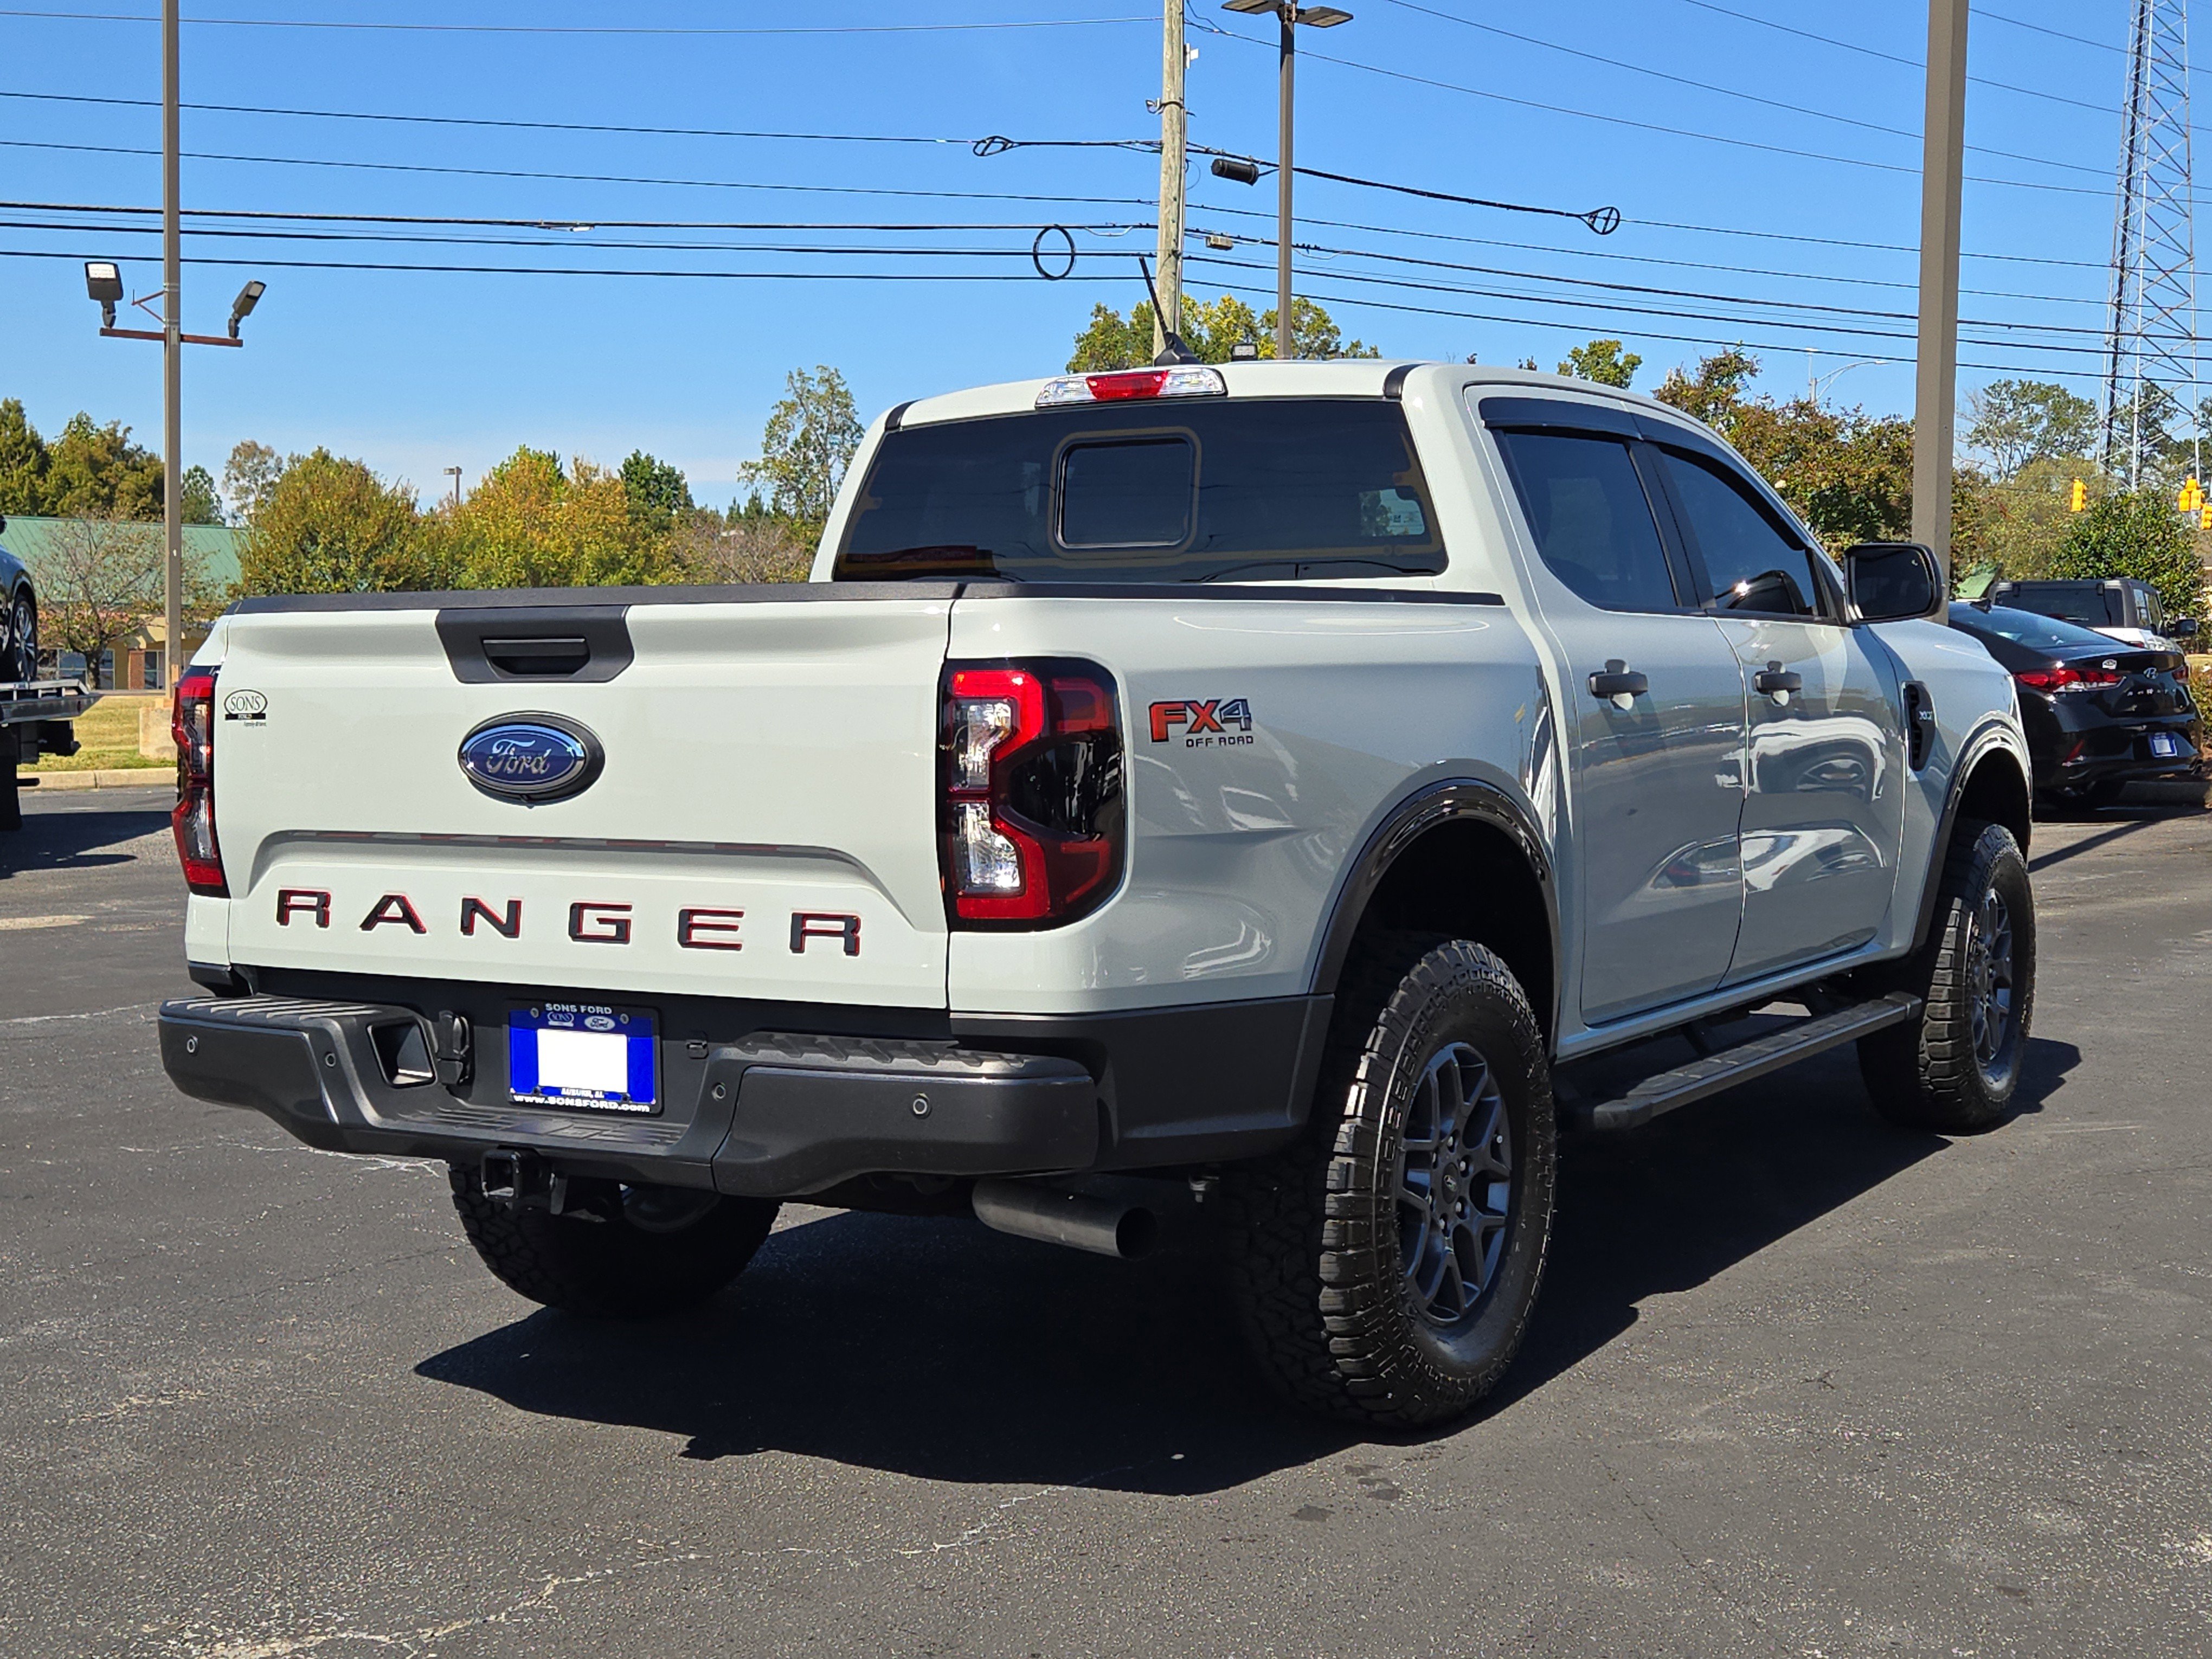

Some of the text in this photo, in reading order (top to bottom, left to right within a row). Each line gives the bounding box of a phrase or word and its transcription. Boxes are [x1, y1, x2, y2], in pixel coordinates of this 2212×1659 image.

[230, 696, 261, 711] SONS
[1148, 698, 1252, 743] FX4
[1186, 735, 1254, 748] OFF ROAD
[486, 738, 552, 775] Ford
[276, 888, 861, 957] RANGER
[545, 1003, 613, 1014] SONS FORD
